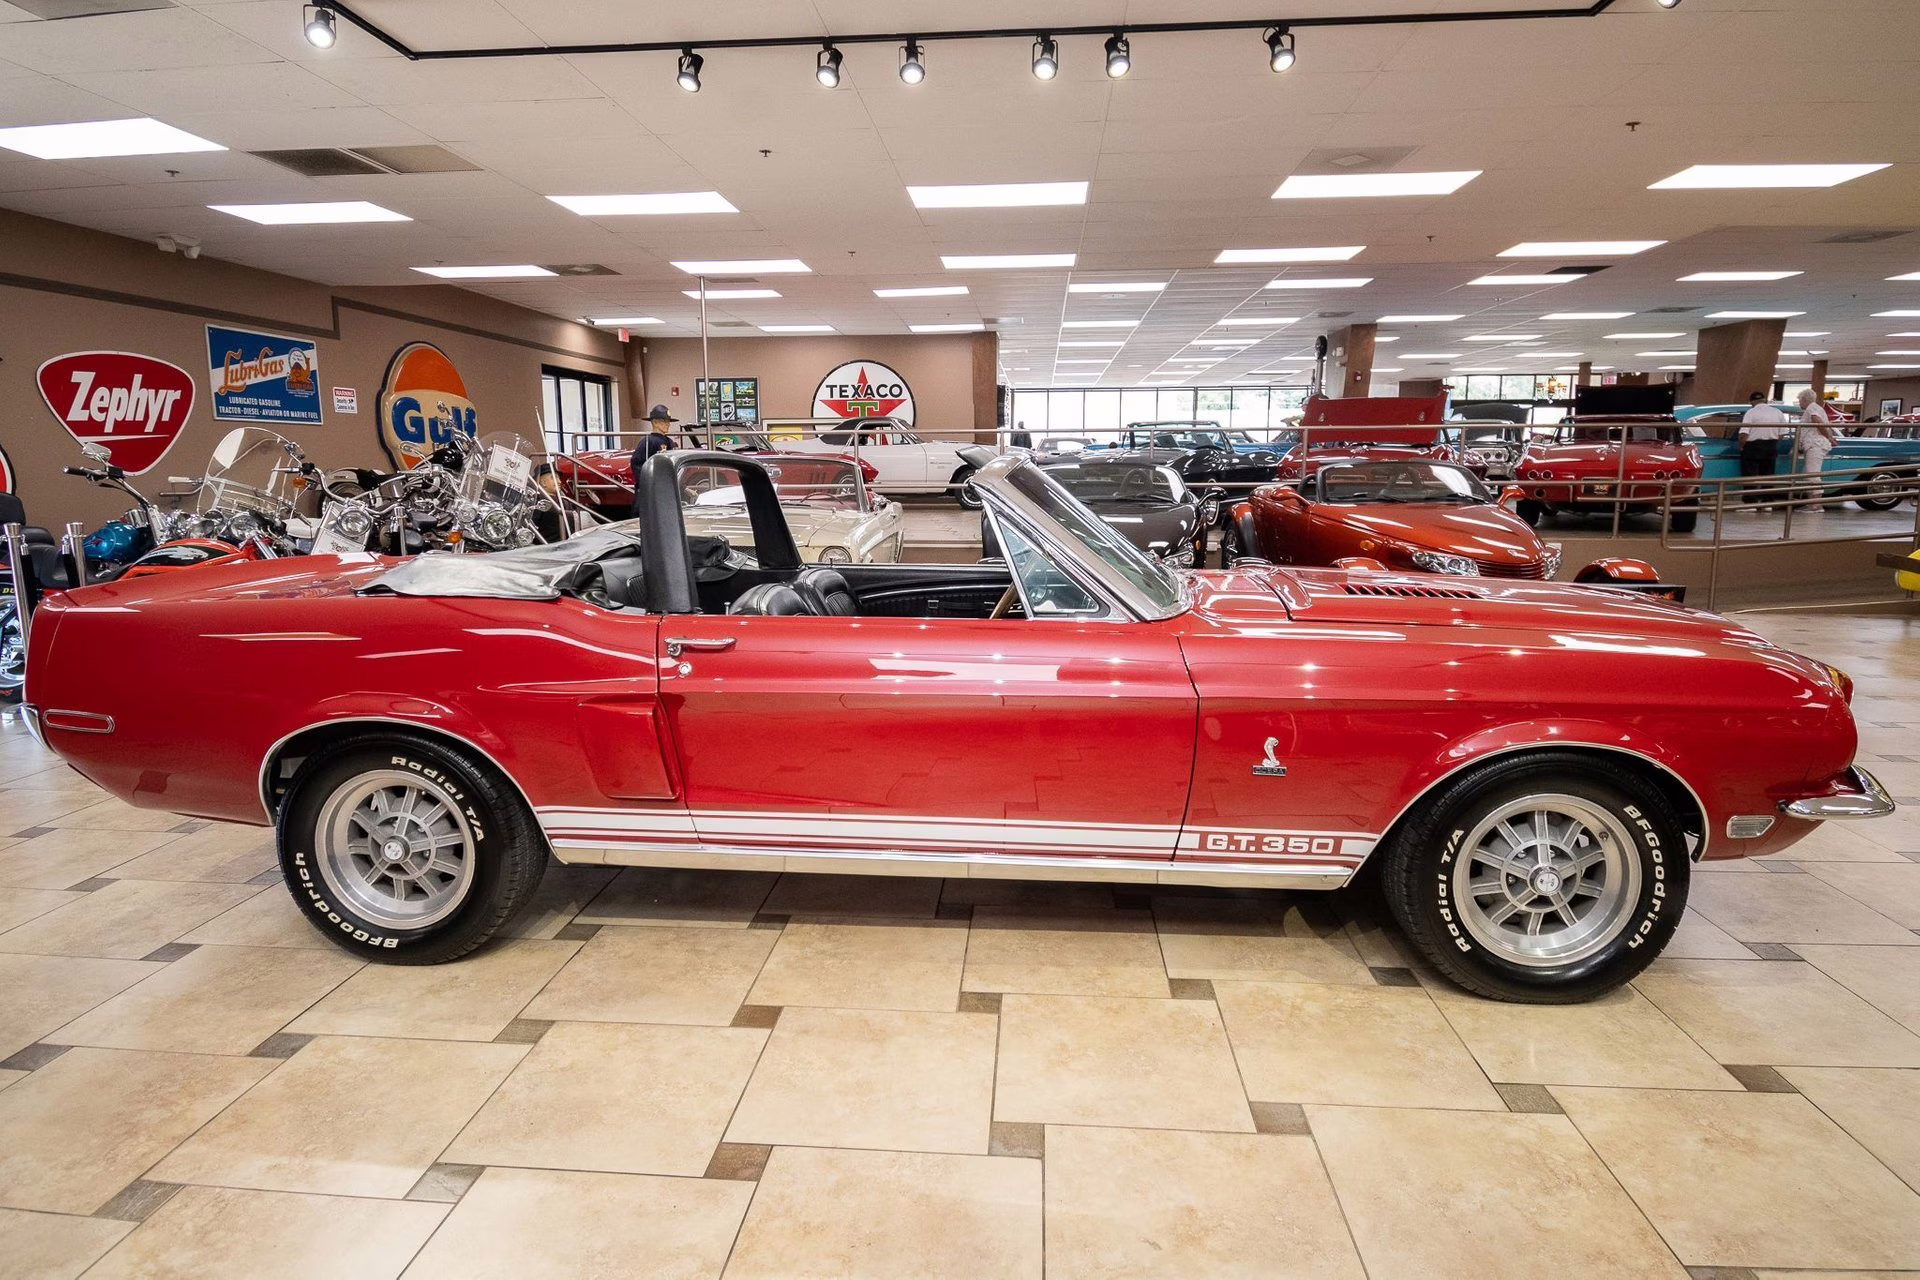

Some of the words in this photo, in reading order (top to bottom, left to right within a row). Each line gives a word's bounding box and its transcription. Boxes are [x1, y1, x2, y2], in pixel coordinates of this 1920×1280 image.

[66, 371, 182, 433] Zephyr
[229, 396, 258, 405] LUBRICATED
[259, 399, 281, 407] GASOLINE
[392, 397, 477, 444] Gulf
[825, 384, 903, 398] TEXACO
[391, 756, 464, 801] Radial
[465, 806, 485, 842] T/A
[1441, 829, 1465, 865] T/A
[1623, 805, 1666, 949] BFGoodrich
[295, 852, 399, 949] BFGoodrich
[1438, 873, 1472, 952] Radial
